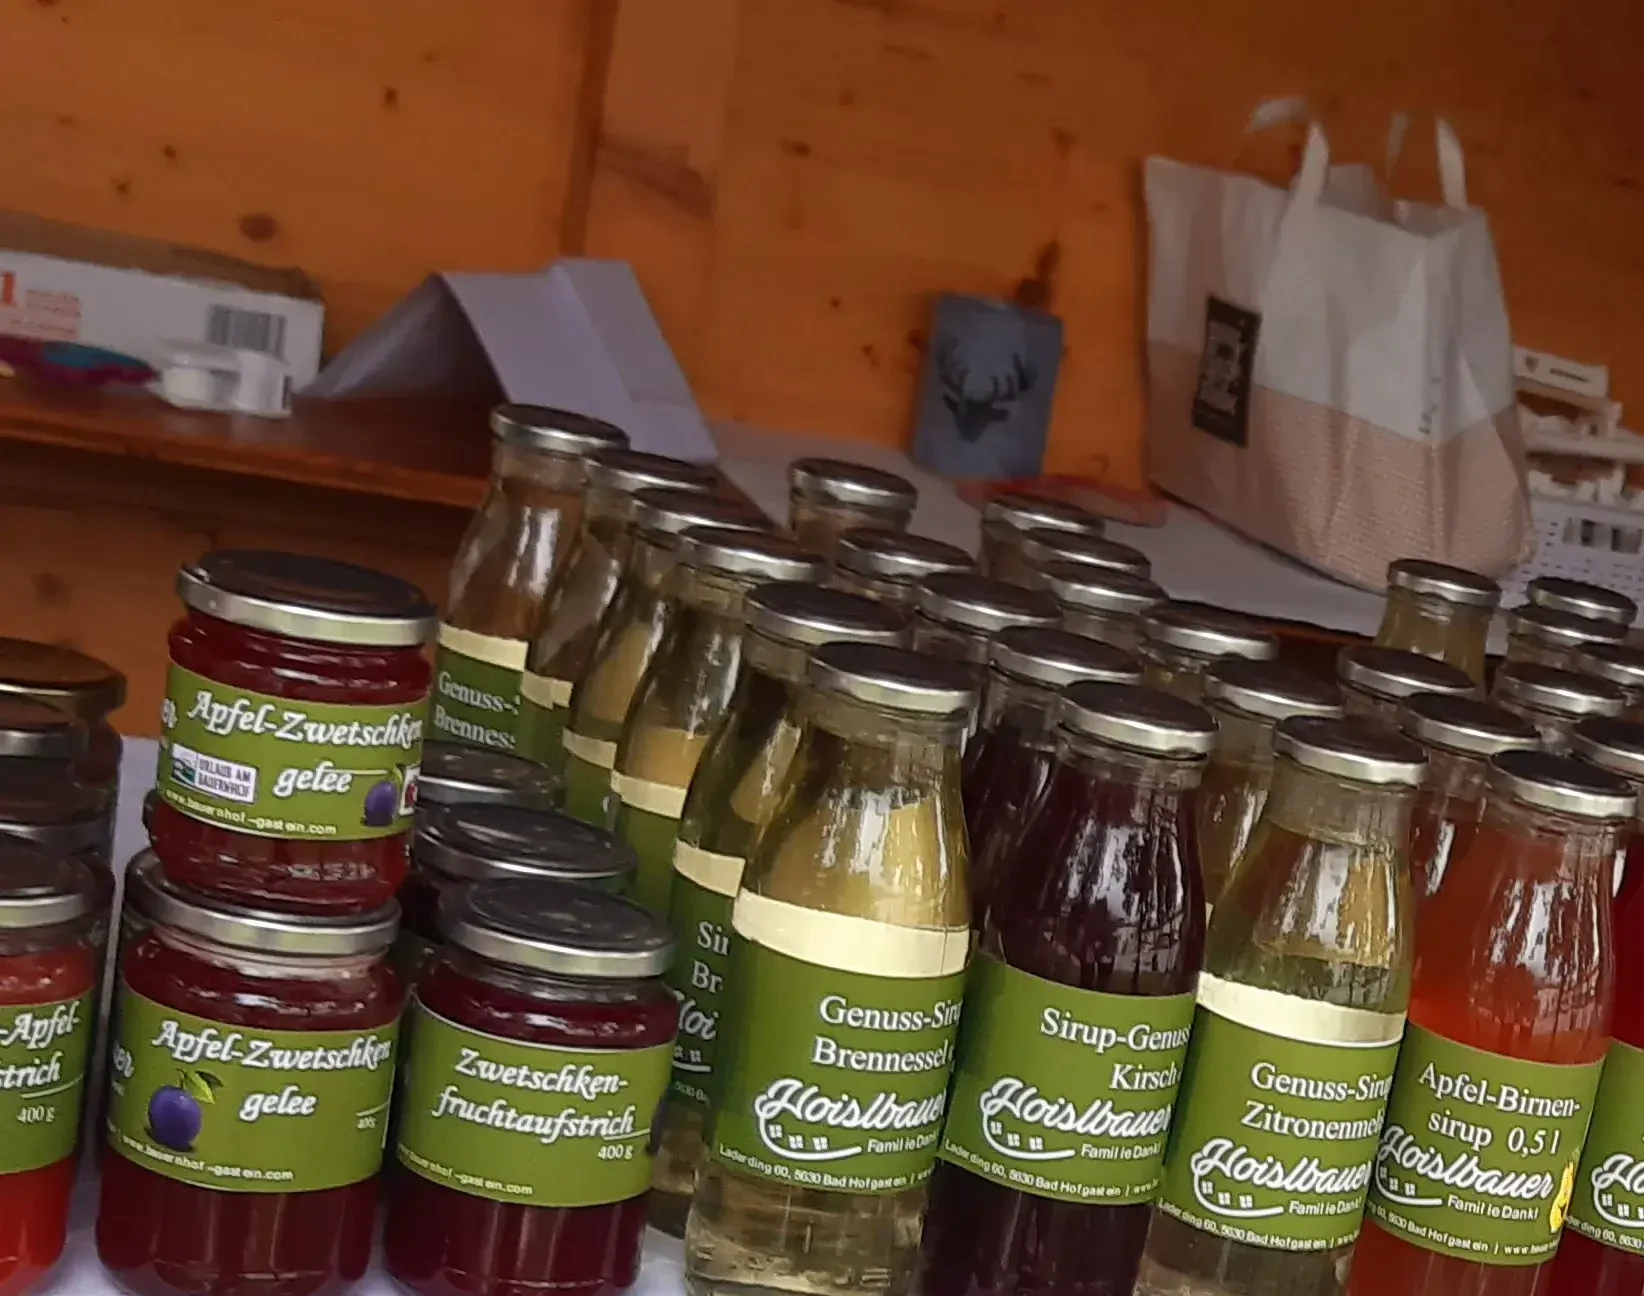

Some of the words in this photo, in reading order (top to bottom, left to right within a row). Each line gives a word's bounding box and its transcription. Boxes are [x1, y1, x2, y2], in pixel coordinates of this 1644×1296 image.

[438, 671, 521, 717] Genuss-
[272, 761, 353, 797] gelee
[453, 1047, 629, 1101] Zwetschken-
[812, 1034, 949, 1074] Brennessel
[1108, 1060, 1177, 1091] Kirsch
[1418, 1061, 1582, 1118] Apfel-Birnen-
[239, 1085, 318, 1122] gelee
[430, 1084, 637, 1144] fruchtaufstrich
[1427, 1108, 1493, 1152] sirup
[1506, 1126, 1547, 1159] 0,5
[822, 1171, 847, 1188] Bad
[1378, 1124, 1555, 1200] Hoislbauer
[1035, 1175, 1059, 1192] Bad
[1407, 1221, 1428, 1238] Bad
